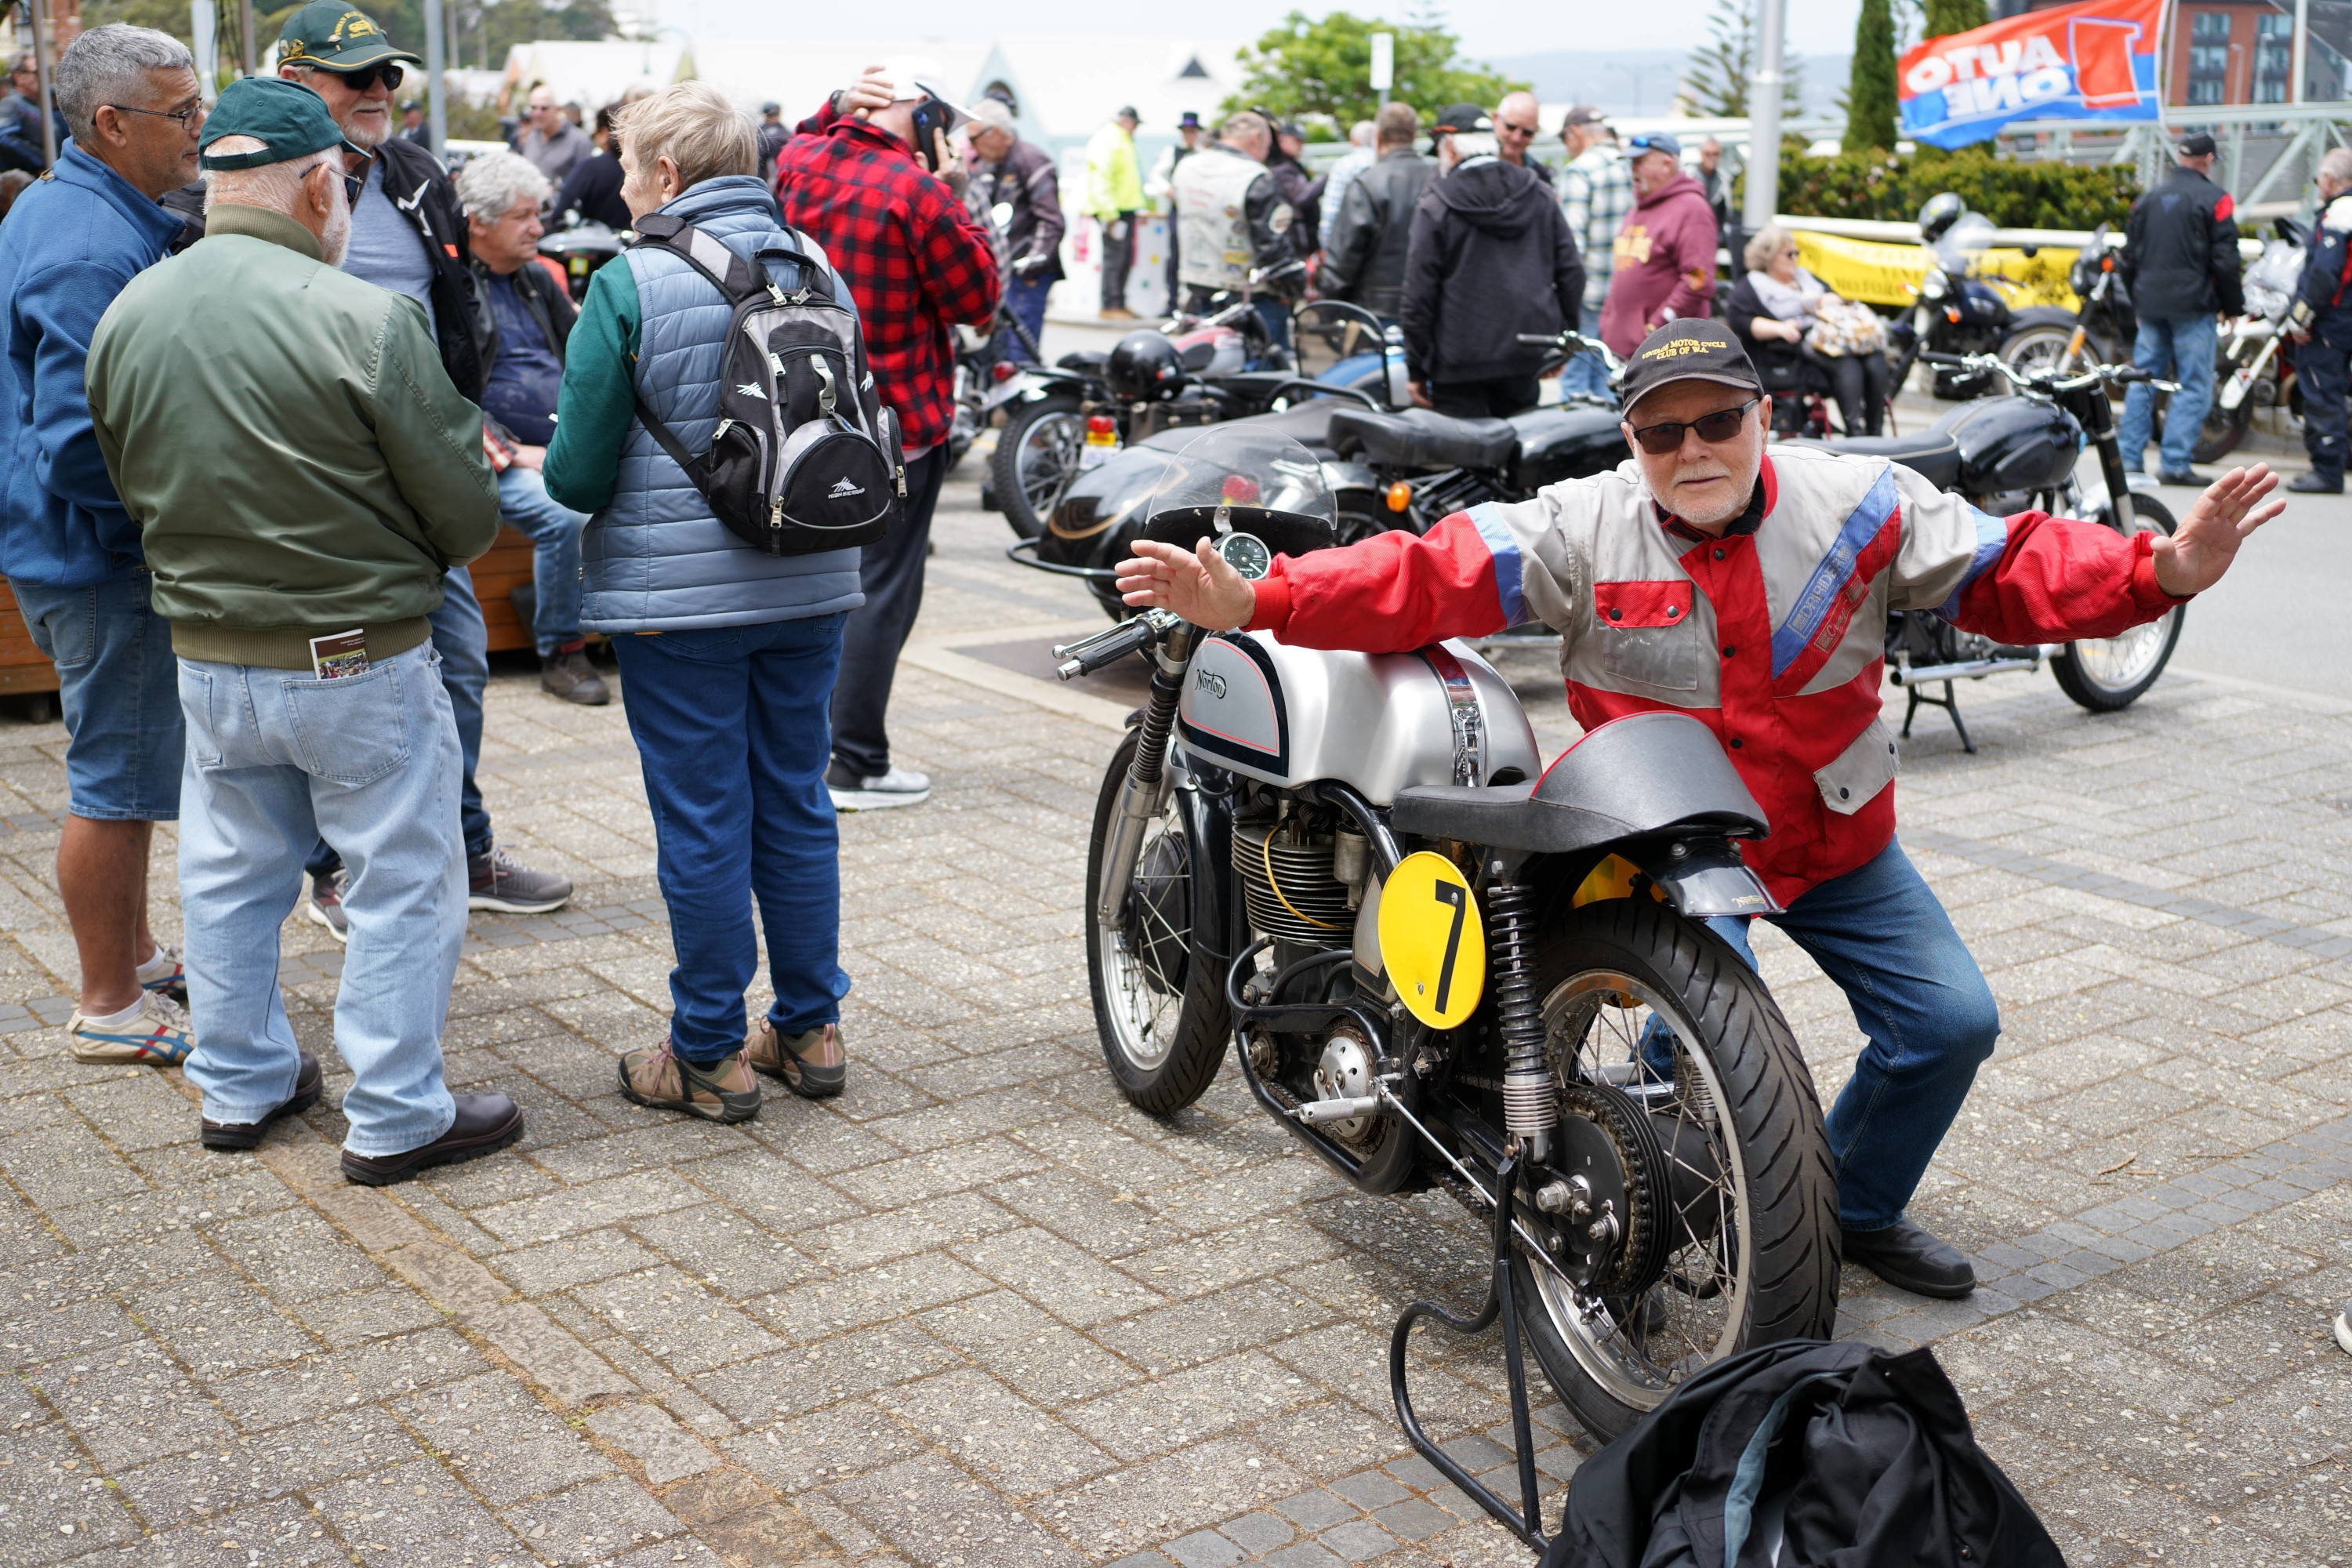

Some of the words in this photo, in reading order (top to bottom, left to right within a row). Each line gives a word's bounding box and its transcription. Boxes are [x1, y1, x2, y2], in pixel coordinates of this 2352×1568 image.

[1642, 343, 1670, 360] VINTAGE
[1670, 339, 1700, 348] MOTOR
[1657, 349, 1677, 360] CLUB
[1799, 556, 1845, 620] DRIRIDER
[1195, 669, 1226, 699] Norton
[1436, 879, 1466, 1014] 7
